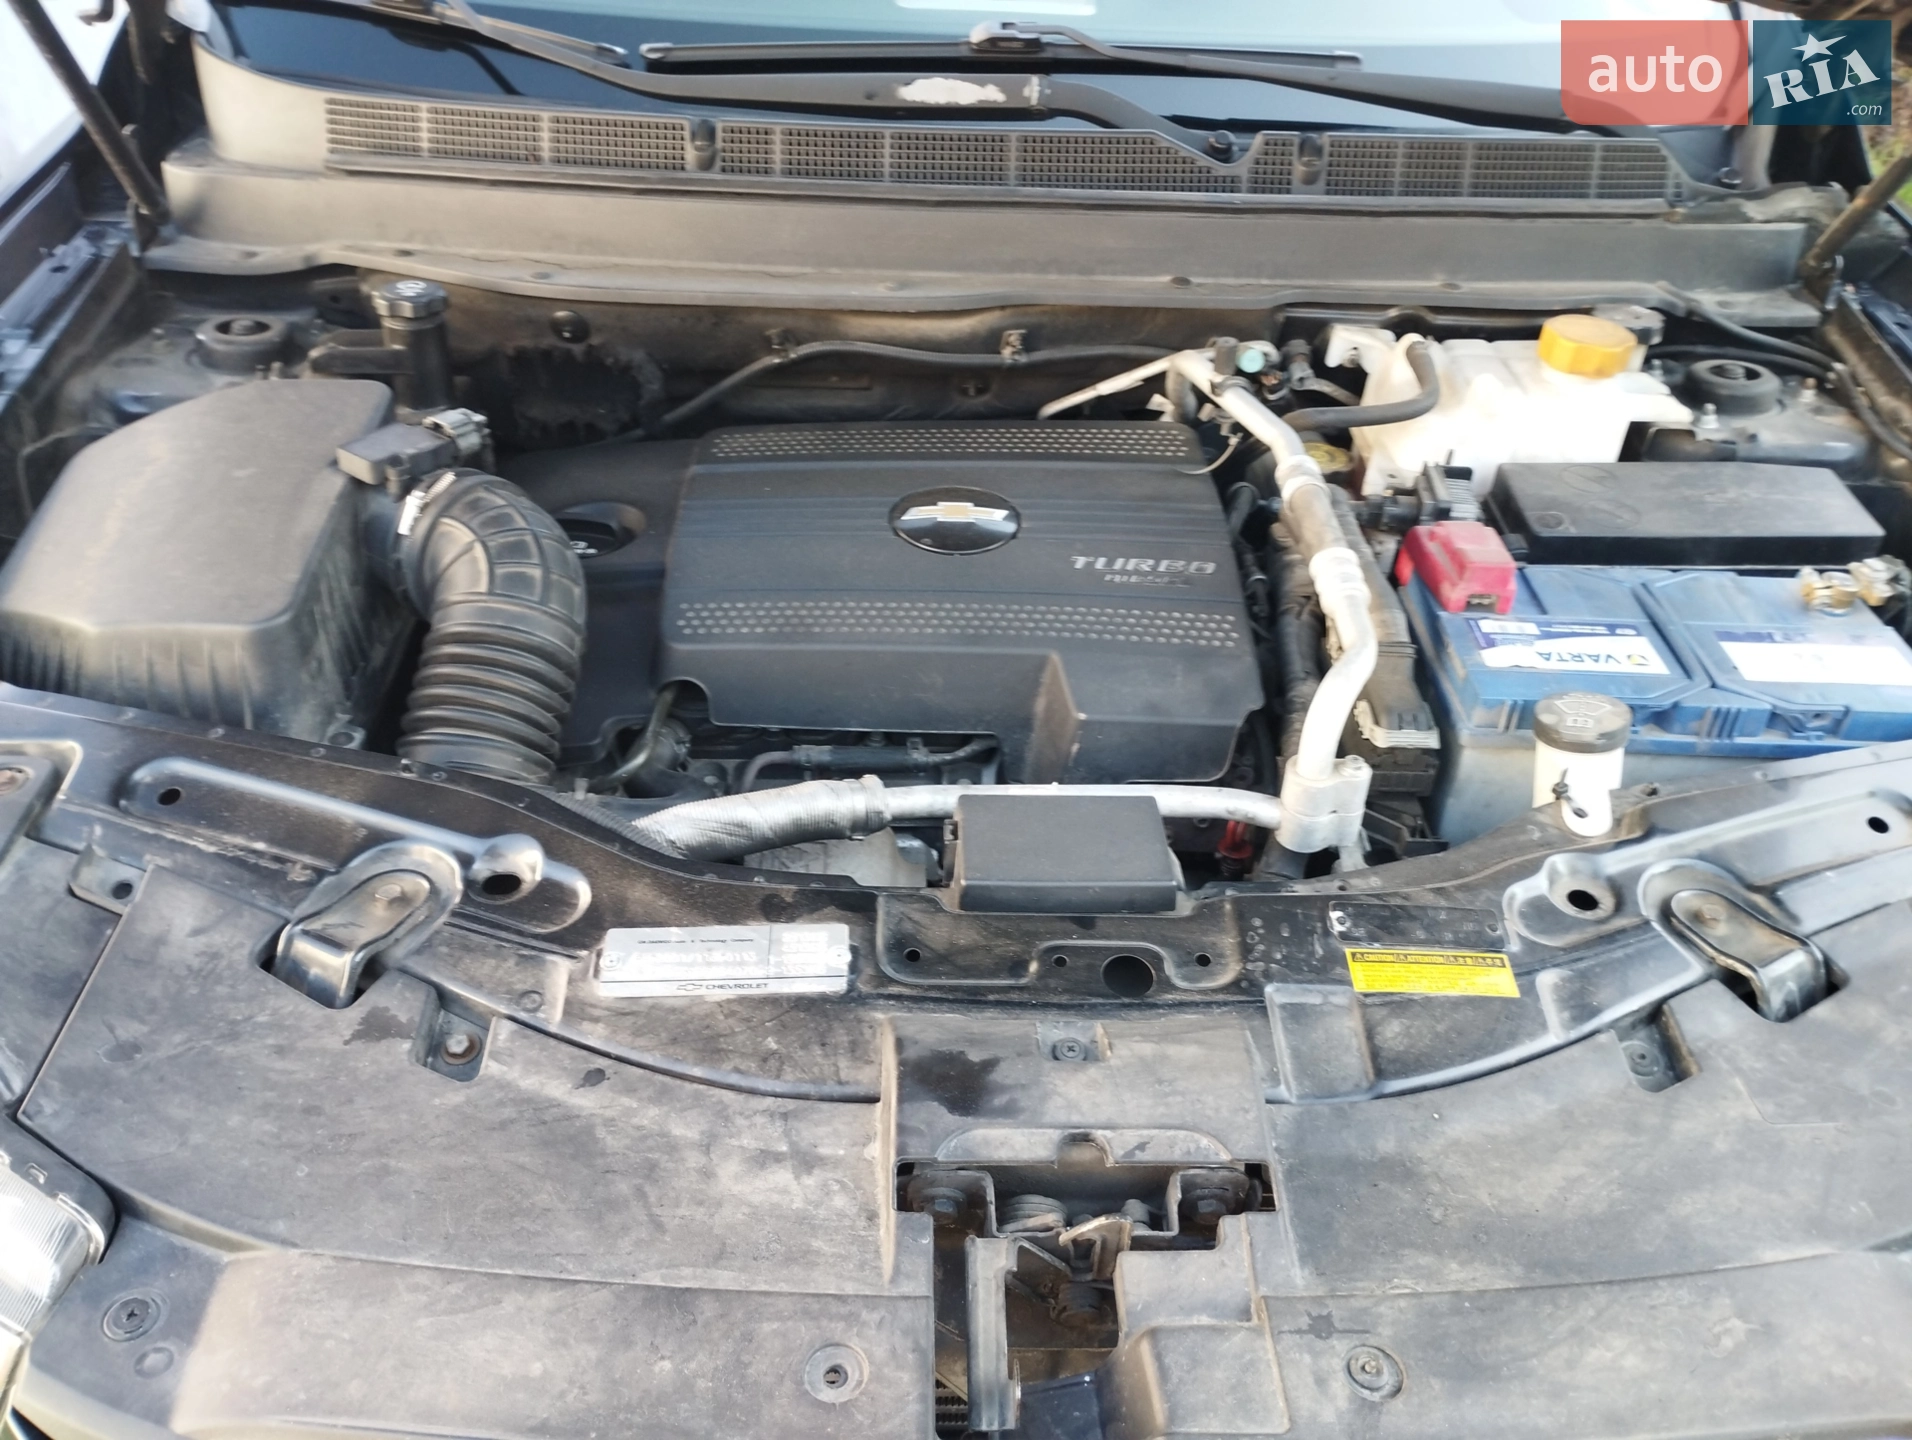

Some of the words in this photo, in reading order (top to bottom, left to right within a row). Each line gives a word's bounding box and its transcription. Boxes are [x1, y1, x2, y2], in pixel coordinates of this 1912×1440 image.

[1070, 555, 1217, 575] TURBO
[1535, 650, 1622, 665] VARTA
[705, 982, 769, 990] CHEVROLET
